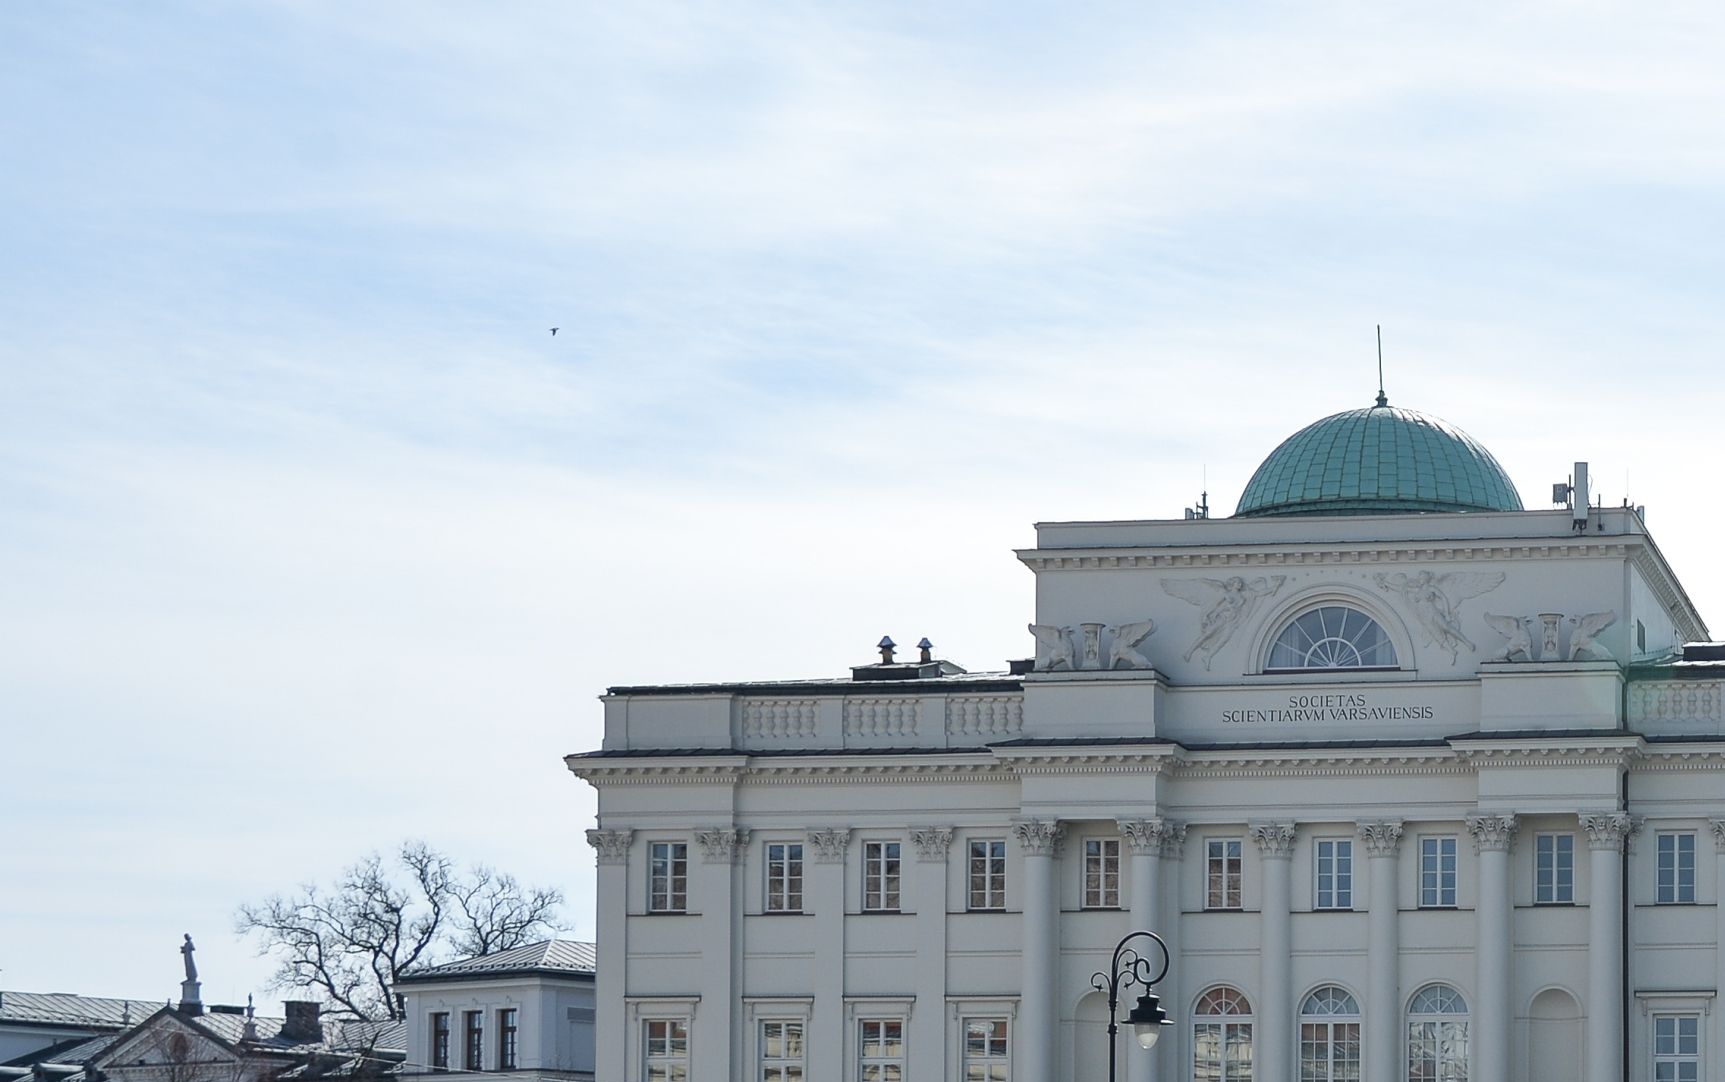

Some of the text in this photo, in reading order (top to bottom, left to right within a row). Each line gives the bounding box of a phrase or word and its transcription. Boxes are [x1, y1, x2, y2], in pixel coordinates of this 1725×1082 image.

[1289, 694, 1366, 709] SOCIETAS
[1222, 706, 1434, 723] SCIENTIARVM VARSAVIENSIS
